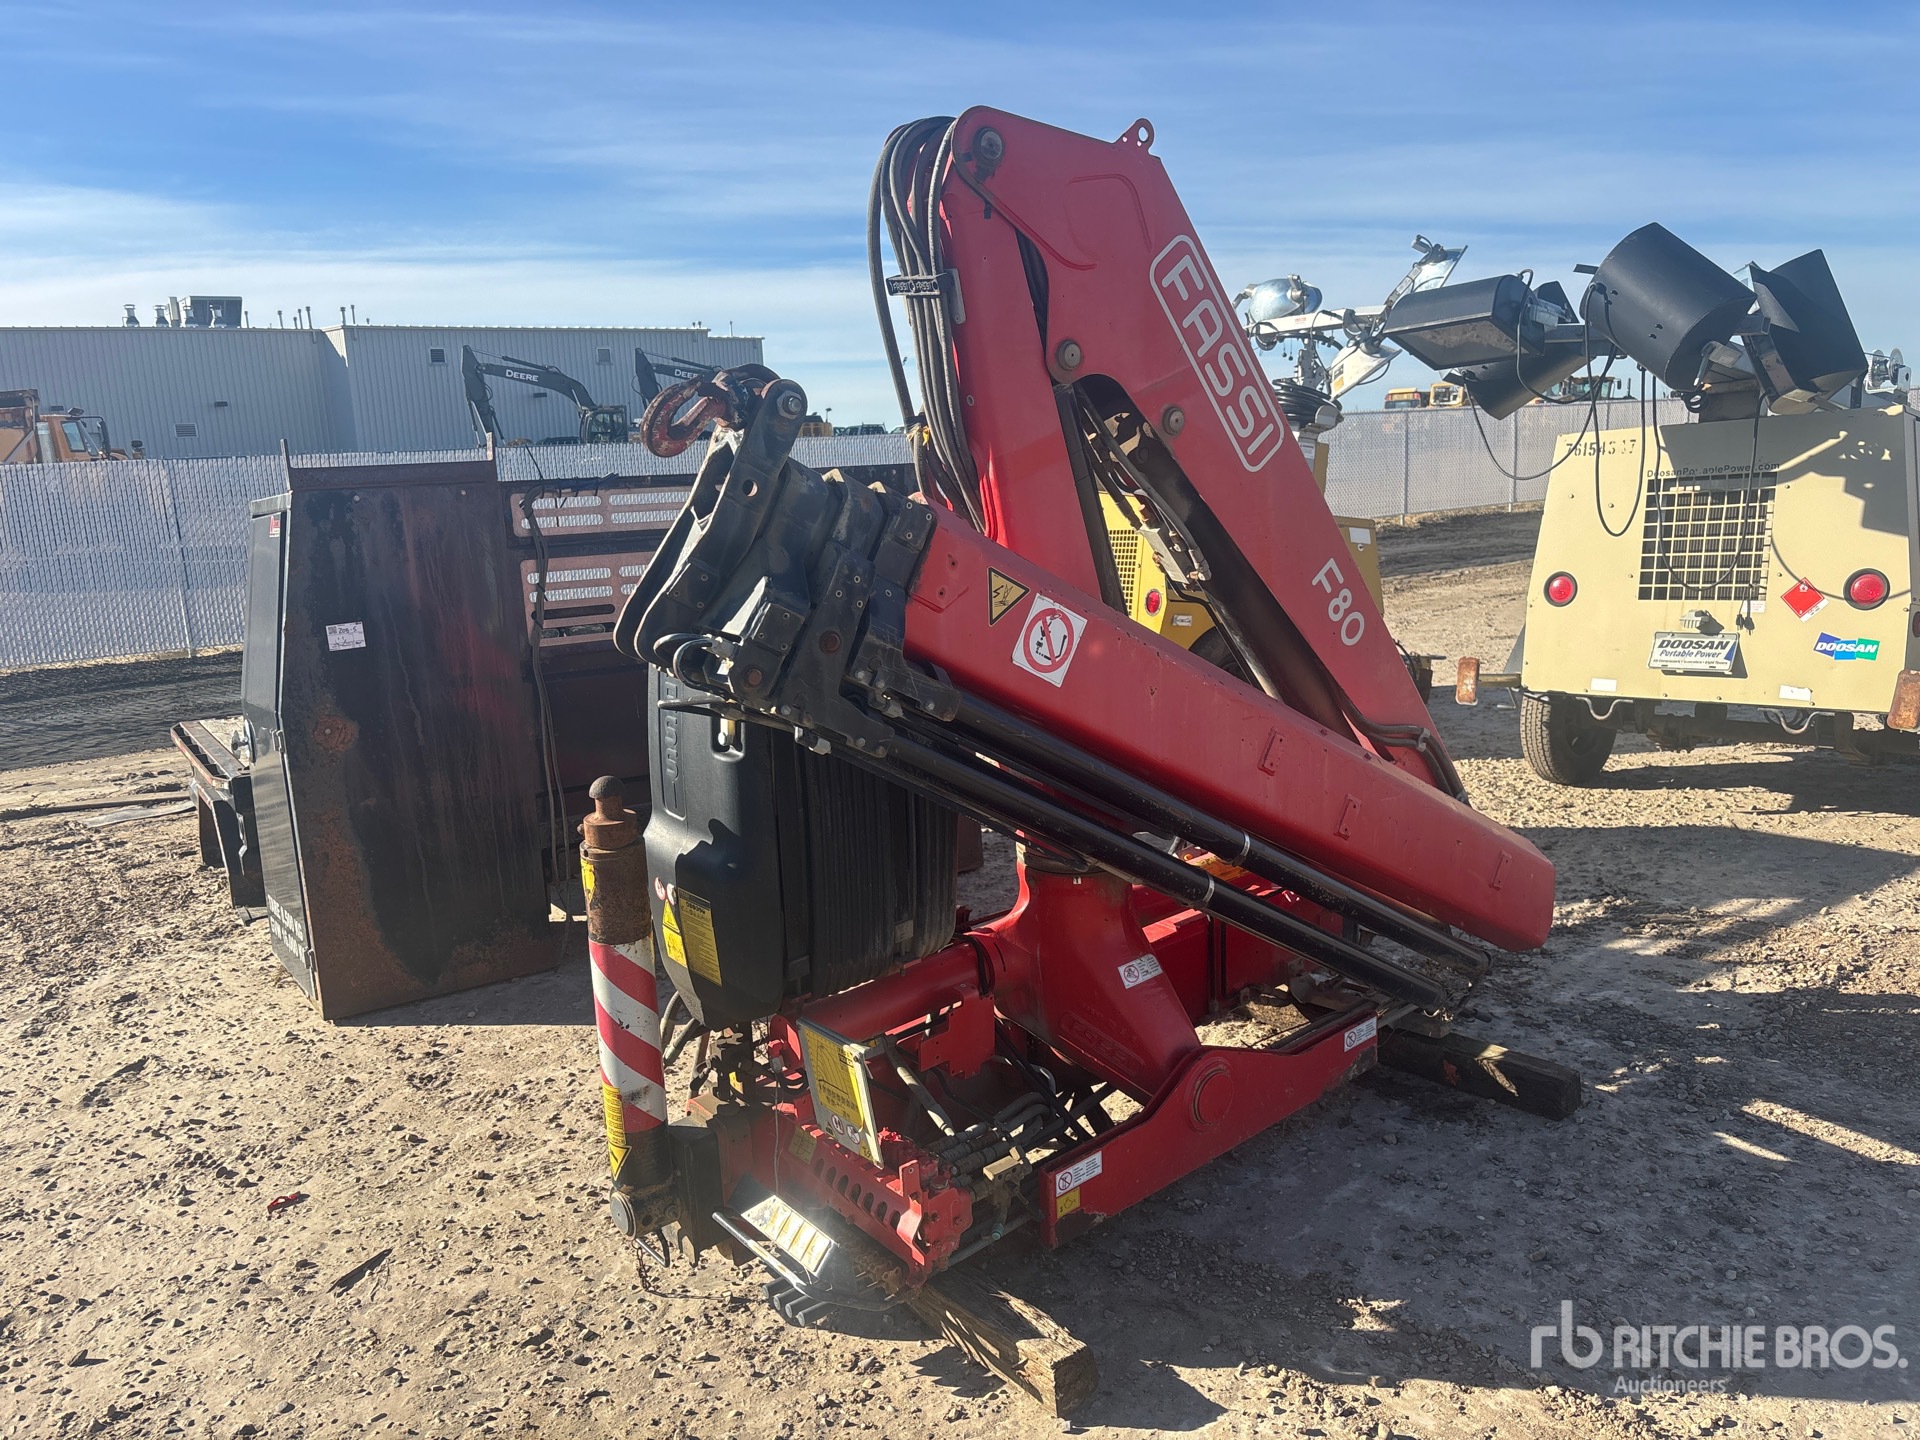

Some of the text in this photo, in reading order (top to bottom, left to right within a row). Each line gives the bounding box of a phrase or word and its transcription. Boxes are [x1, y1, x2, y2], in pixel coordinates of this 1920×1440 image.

[1161, 254, 1274, 456] FASSI
[505, 368, 539, 383] DEERE
[1311, 557, 1365, 646] F80
[1658, 639, 1730, 650] DOOSAN
[1815, 642, 1878, 653] DOOSAN
[1659, 649, 1722, 659] Portable Power
